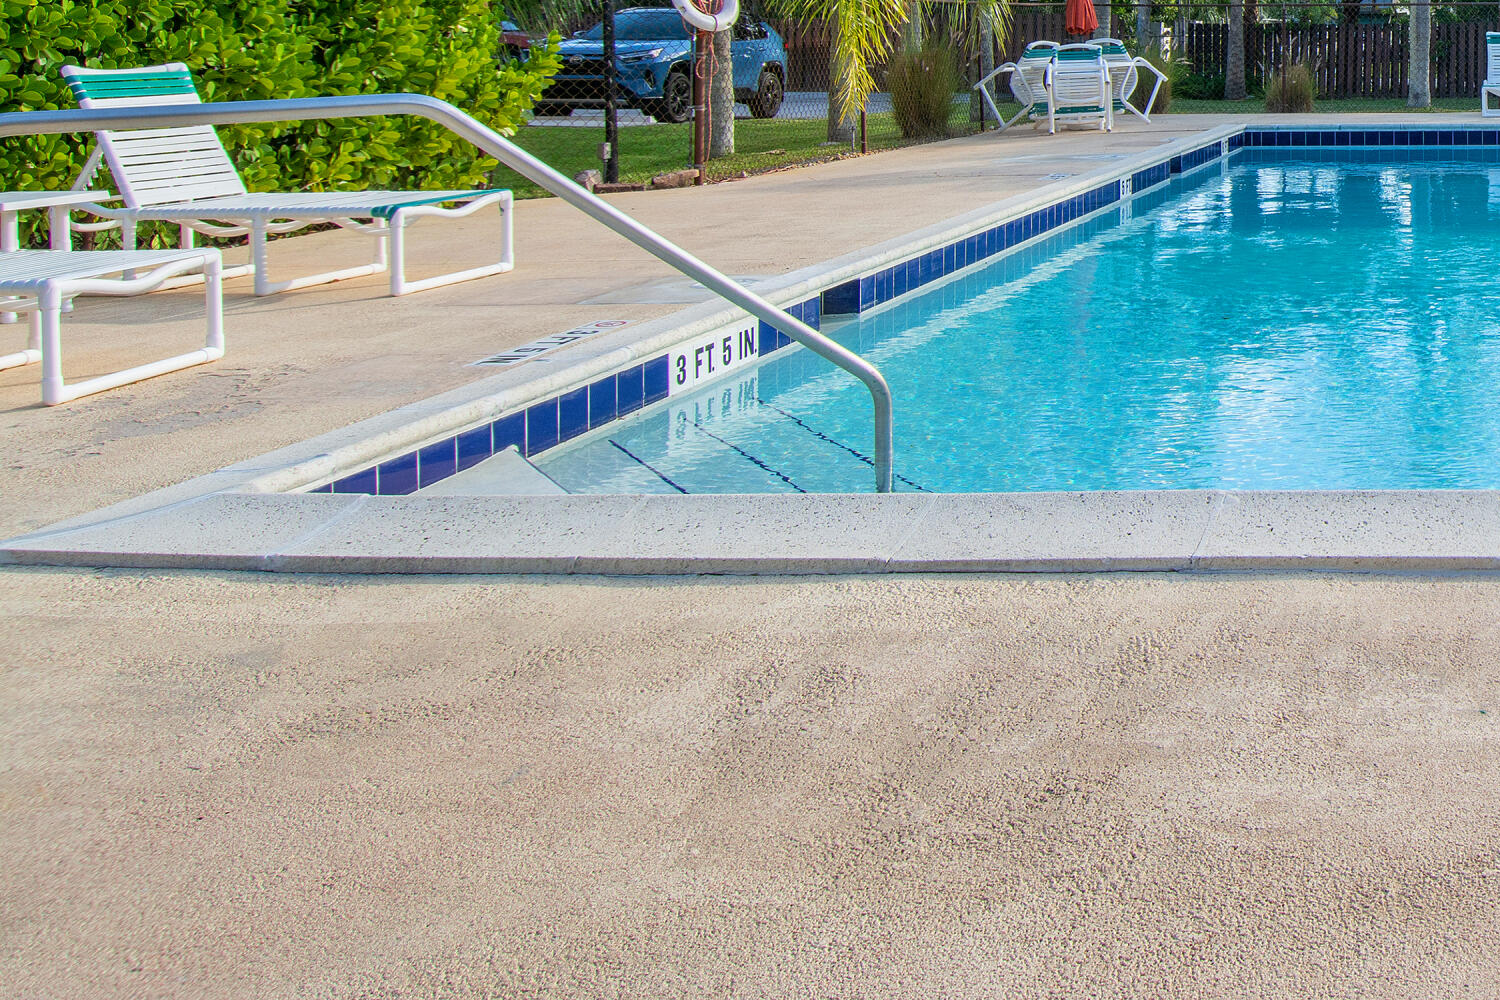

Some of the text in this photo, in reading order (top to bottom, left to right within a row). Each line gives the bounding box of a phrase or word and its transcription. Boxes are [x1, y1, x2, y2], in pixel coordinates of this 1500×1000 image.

[676, 326, 757, 385] 3 FT. 5 IN.
